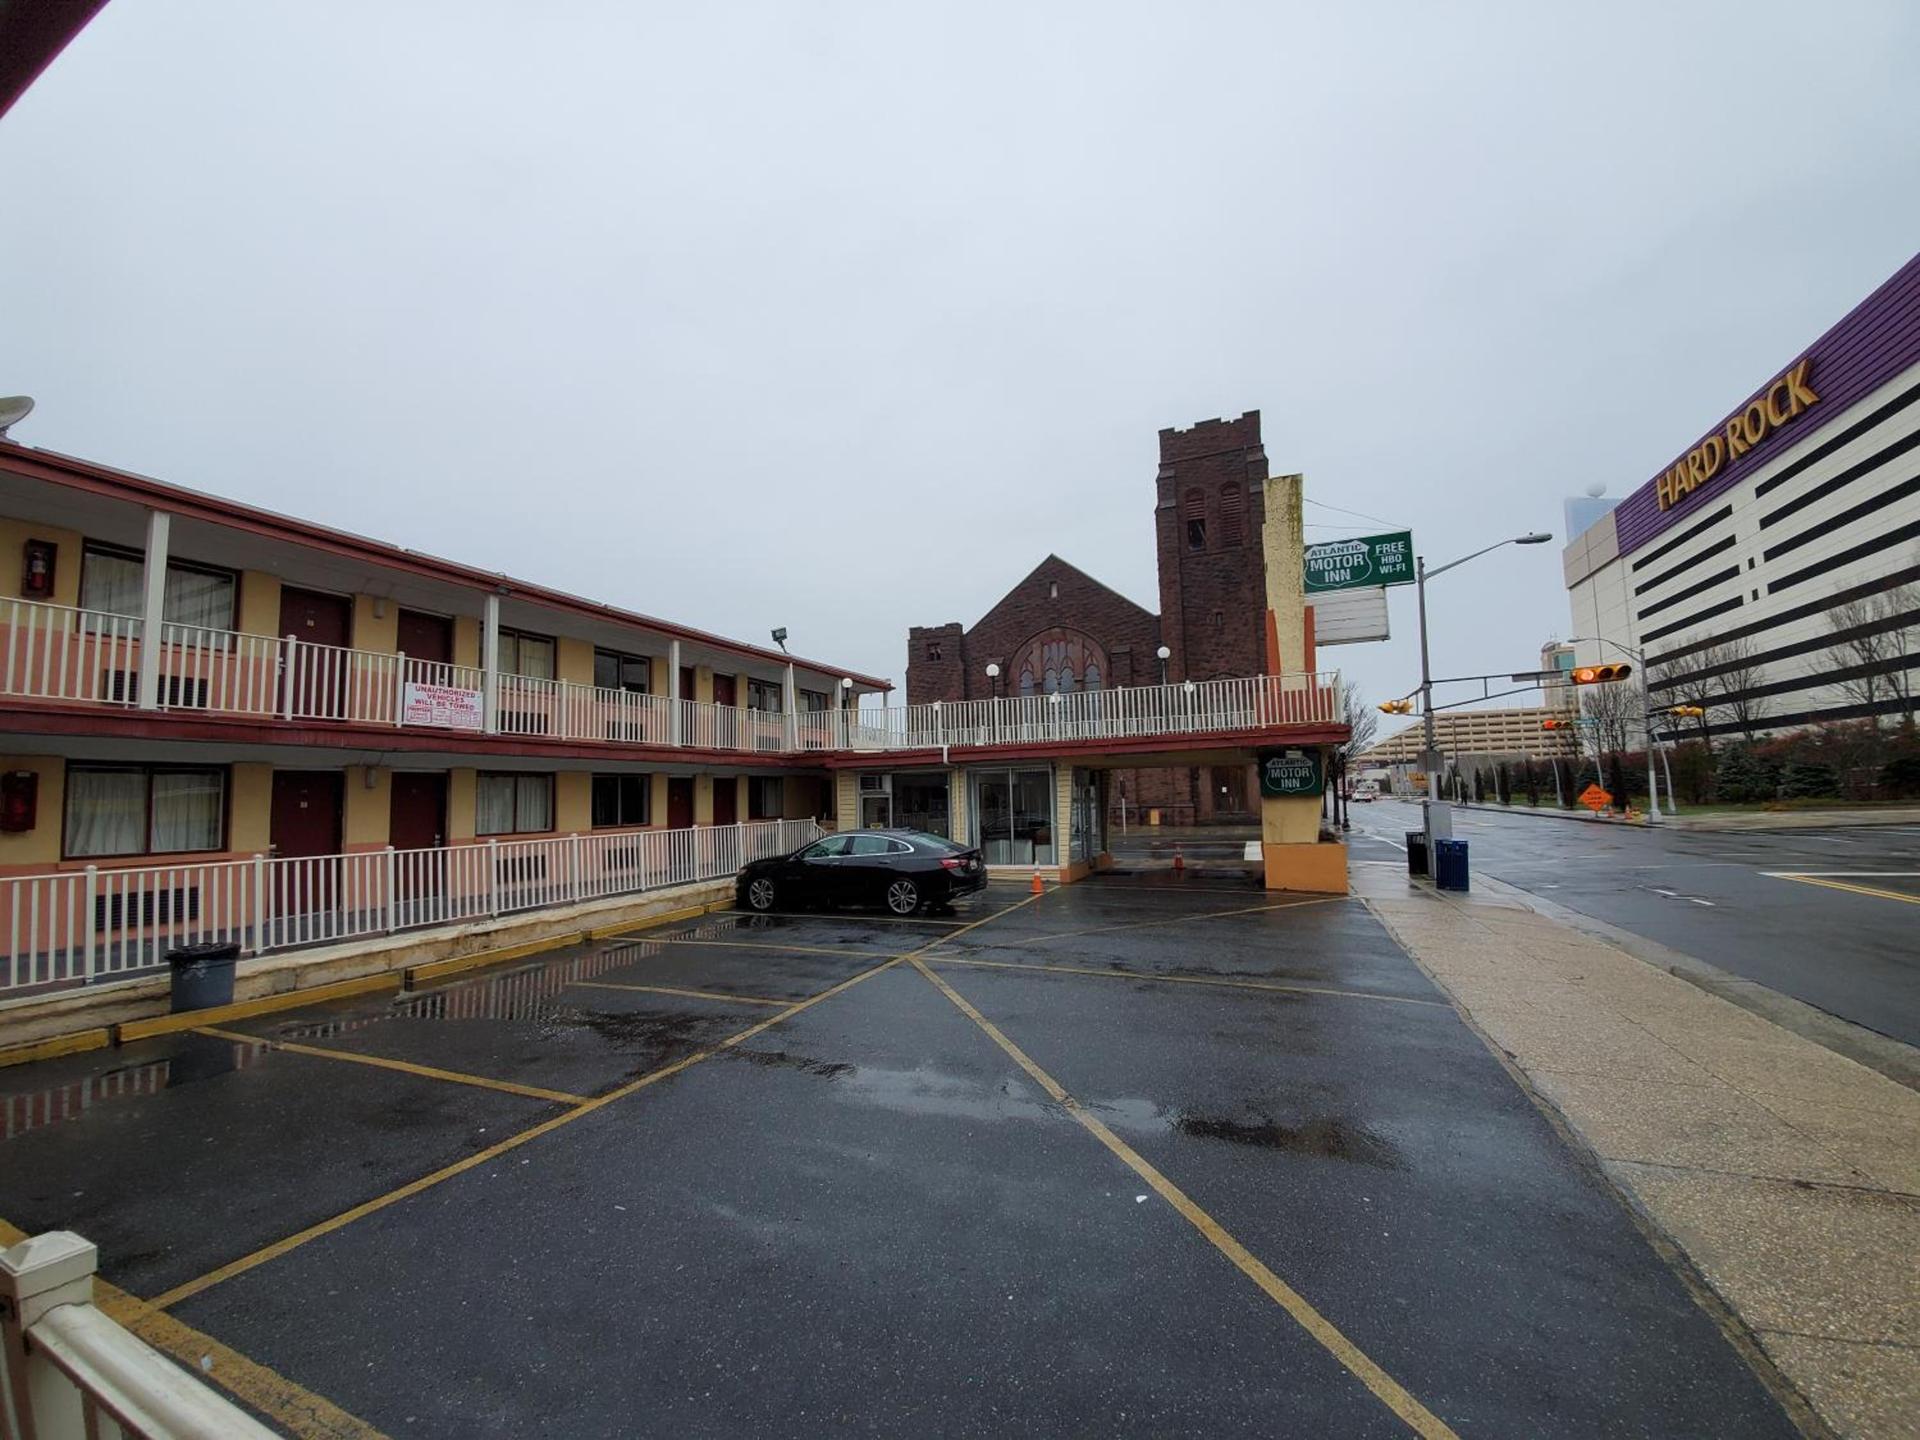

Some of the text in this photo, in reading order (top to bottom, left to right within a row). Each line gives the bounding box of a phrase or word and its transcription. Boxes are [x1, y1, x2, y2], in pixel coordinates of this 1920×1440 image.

[1656, 358, 1821, 512] HARD ROCK
[1310, 543, 1362, 557] ATLANTIC
[1375, 541, 1406, 555] FREE
[1310, 554, 1364, 572] MOTOR
[1381, 554, 1402, 564] HBO
[1379, 563, 1406, 574] WI-FI
[1324, 569, 1351, 583] INN
[415, 686, 475, 698] UNAUTHORIZED
[426, 693, 465, 703] VEHICLES
[449, 702, 475, 710] TOWED
[1271, 767, 1310, 778] MOTOR
[1281, 778, 1300, 788] INN
